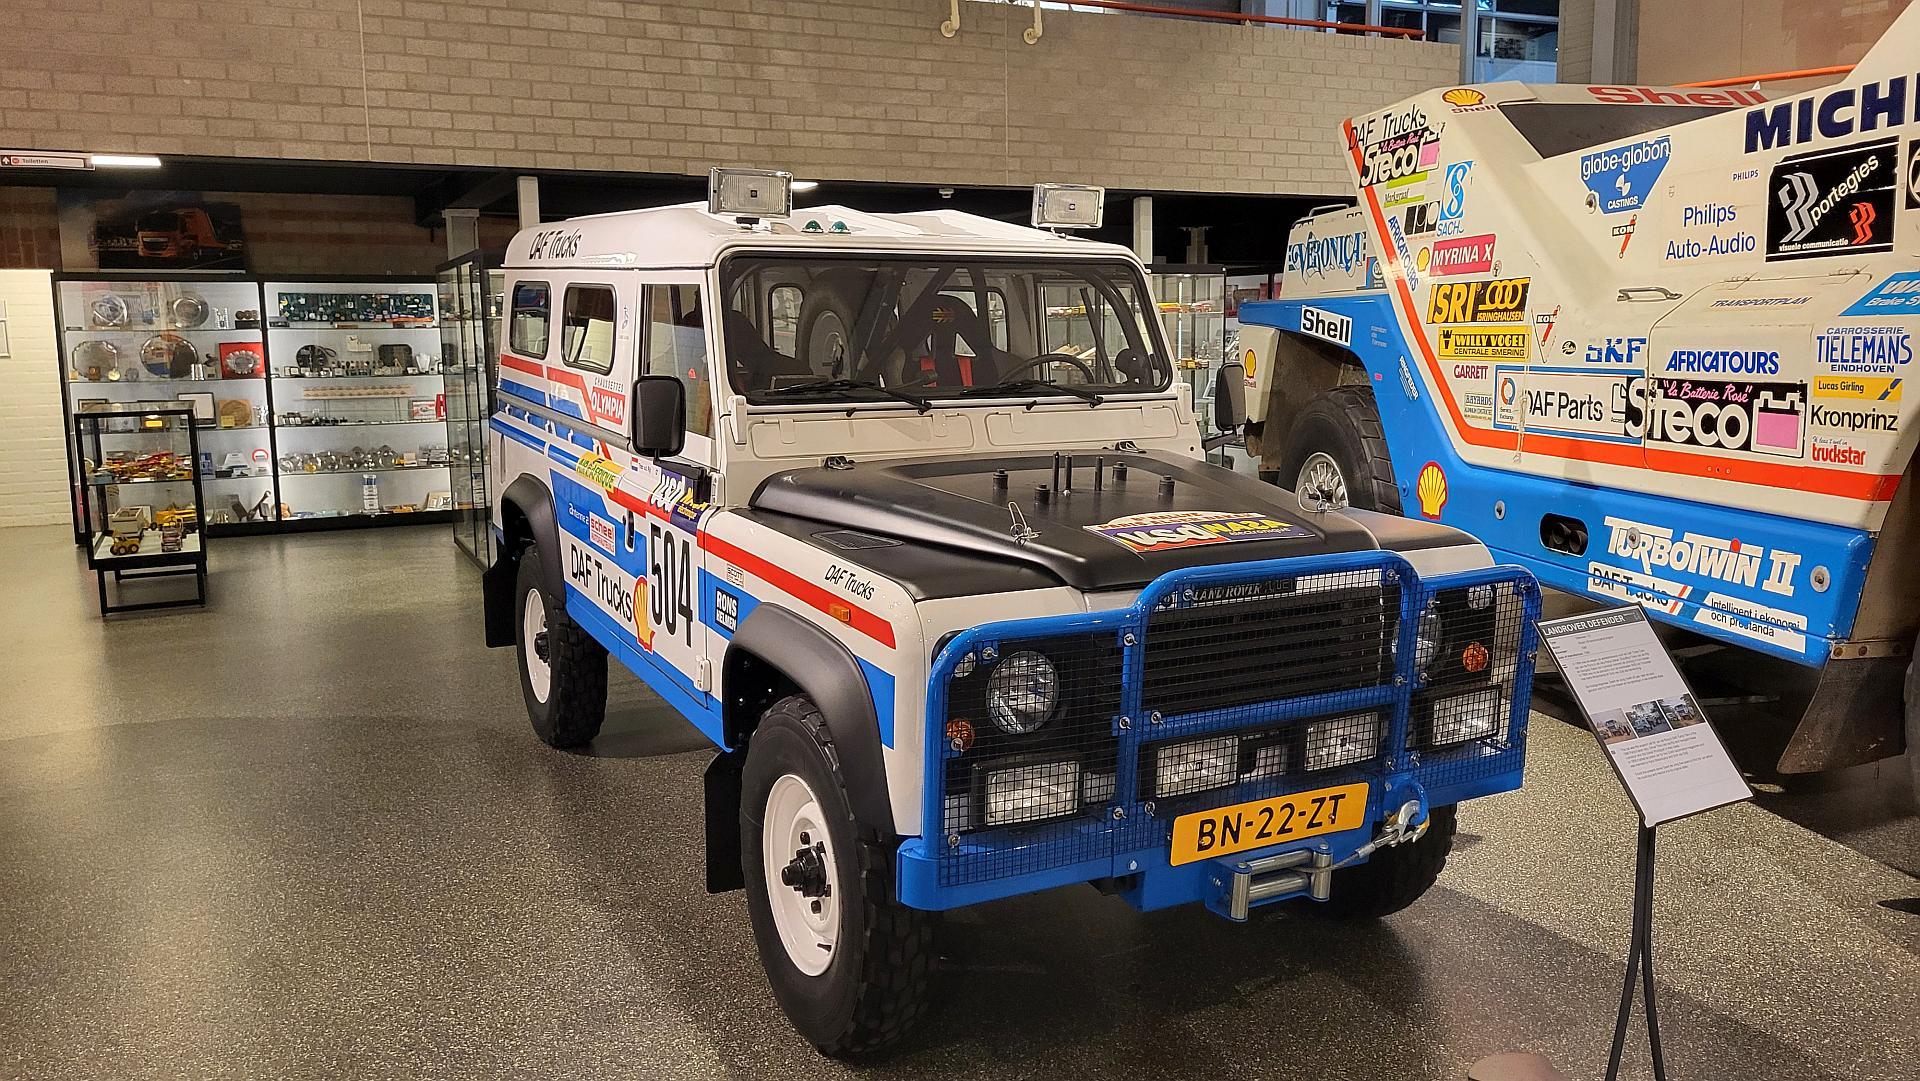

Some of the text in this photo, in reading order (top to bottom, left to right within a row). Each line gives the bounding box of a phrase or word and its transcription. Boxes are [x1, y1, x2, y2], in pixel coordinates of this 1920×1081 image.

[1587, 87, 1771, 106] Shell
[1451, 104, 1497, 114] Shell
[1744, 72, 1920, 154] MICH
[1348, 104, 1427, 151] DAF Trucks
[1362, 142, 1418, 186] Steco
[1733, 170, 1759, 181] PHILIPS
[1810, 155, 1879, 226] portegies
[1608, 196, 1638, 210] CASTINGS
[1684, 203, 1736, 227] Philips
[529, 228, 581, 260] DAF Trucks
[1432, 243, 1494, 267] MYRINA X
[1666, 231, 1756, 260] Auto-Audio
[1427, 283, 1478, 323] ISRI
[1710, 296, 1813, 308] TRANSPORTPLAN
[1864, 297, 1903, 307] Brake
[1302, 309, 1350, 343] Shell
[1477, 311, 1524, 322] ISRINGHAUSEN
[1455, 335, 1525, 347] WILLY VOGEL
[1827, 327, 1904, 335] CARROSSERIE
[1491, 348, 1525, 356] SMERING
[1817, 334, 1912, 365] TIELEMANS
[1454, 365, 1488, 380] GARRETT
[1666, 350, 1779, 374] AFRICATOURS
[1831, 364, 1894, 373] EINDHOVEN
[1680, 381, 1720, 400] Batterie
[1818, 381, 1864, 393] Lucas Girling
[592, 392, 623, 420] OLYMPIA
[1558, 392, 1604, 421] Parts
[1625, 377, 1749, 449] Steco
[1811, 405, 1898, 431] Kronprinz
[1812, 443, 1866, 465] truckstar
[571, 543, 633, 622] DAF Trucks
[651, 522, 693, 648] 504
[825, 564, 875, 601] DAF Trucks
[1593, 567, 1669, 607] DAF Tucks
[717, 591, 737, 617] RONS
[1711, 598, 1753, 618] Intelligent
[716, 609, 737, 632] HELMEN
[1542, 614, 1626, 636] LANDROVER DEFENDER
[1711, 611, 1727, 624] och
[1197, 793, 1346, 852] BN-22-ZT
